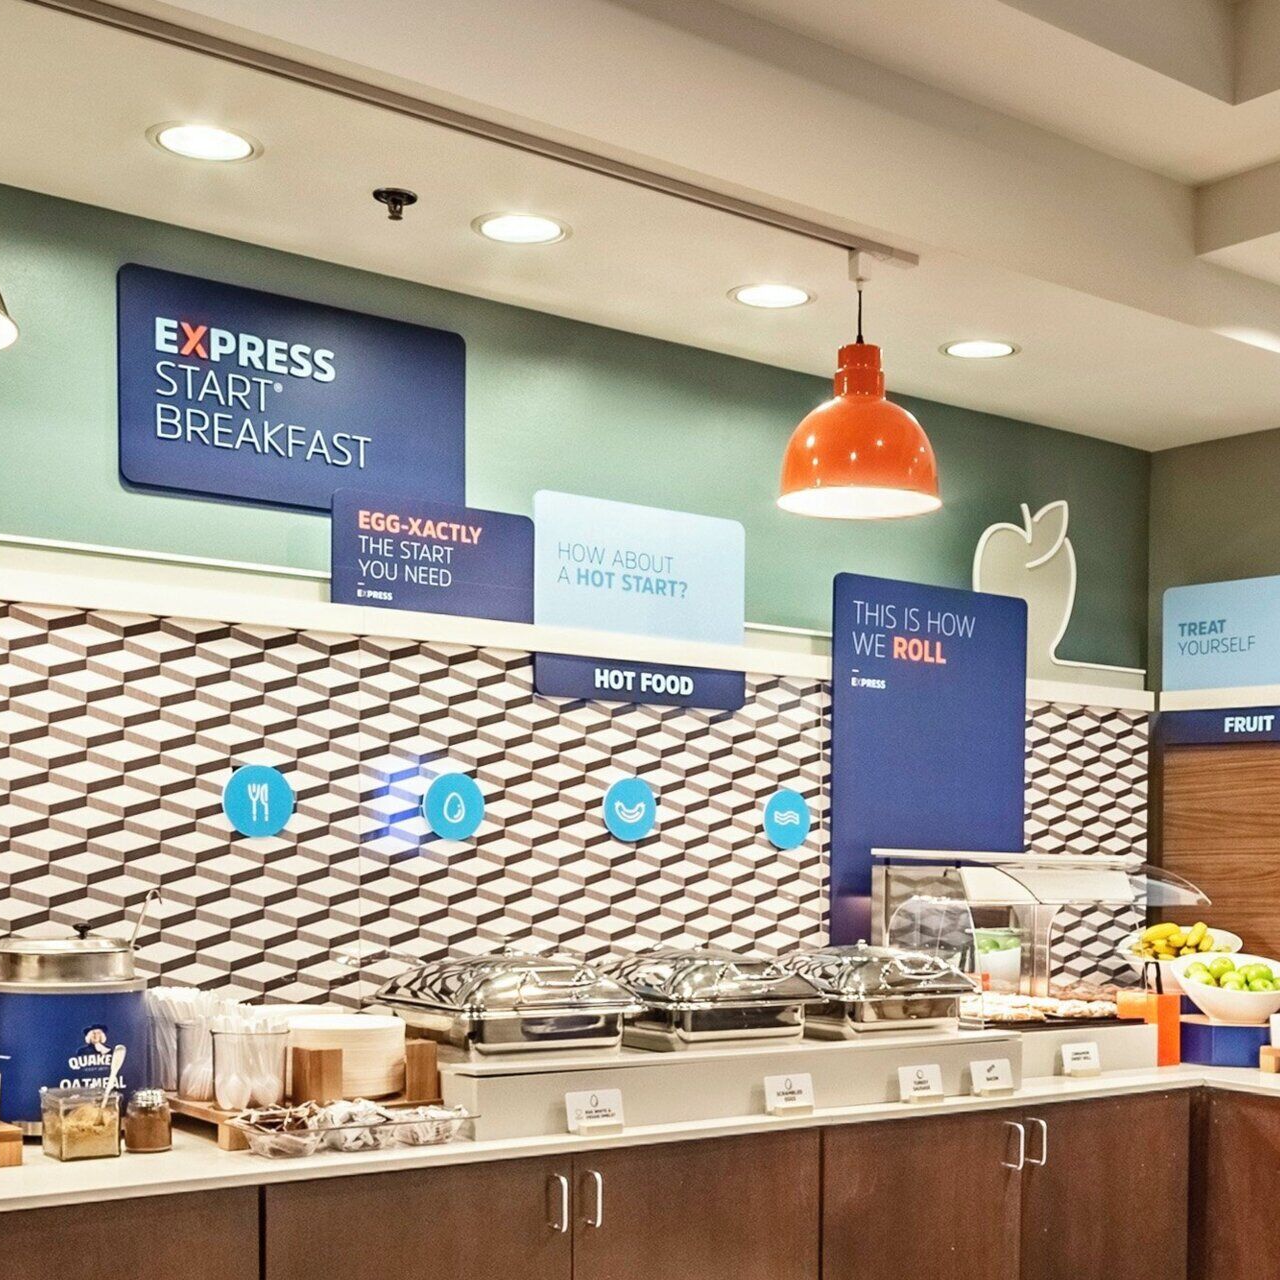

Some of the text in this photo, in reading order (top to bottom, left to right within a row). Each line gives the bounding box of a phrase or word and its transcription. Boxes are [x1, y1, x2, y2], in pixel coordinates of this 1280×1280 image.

[154, 316, 336, 383] EXPRESS
[155, 402, 372, 469] BREAKFAST
[357, 510, 483, 545] EGG-XACTLY
[357, 535, 454, 565] THE START
[558, 541, 675, 574] HOW ABOUT
[357, 559, 452, 588] YOU NEED
[556, 566, 688, 599] A HOT START?
[356, 588, 394, 601] EXPRESS
[852, 600, 976, 638] THIS IS HOW
[1177, 619, 1227, 638] TREAT
[851, 631, 947, 664] WE ROLL
[1177, 635, 1256, 656] YOURSELF
[594, 668, 694, 697] HOT FOOD
[850, 676, 886, 690] EXPRESS
[1223, 714, 1275, 733] FRUIT
[68, 1054, 113, 1070] QUAKE
